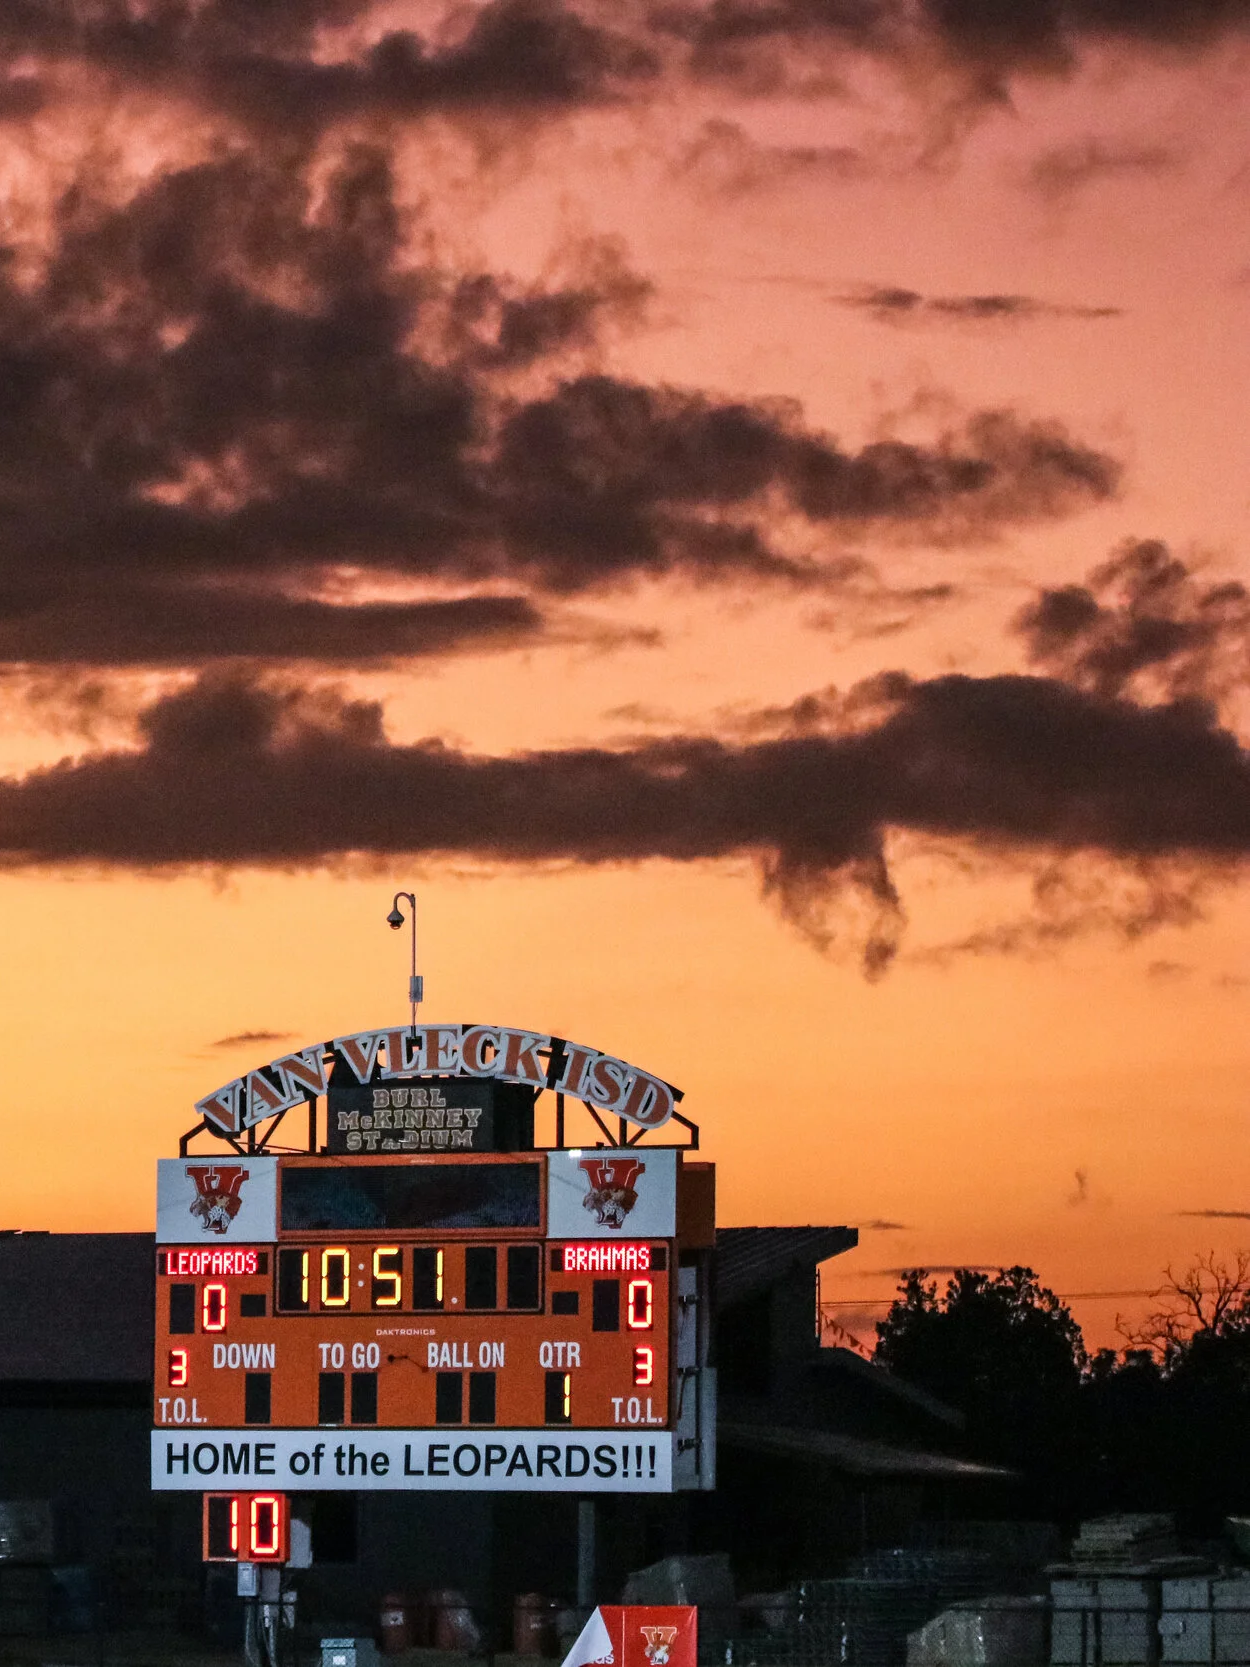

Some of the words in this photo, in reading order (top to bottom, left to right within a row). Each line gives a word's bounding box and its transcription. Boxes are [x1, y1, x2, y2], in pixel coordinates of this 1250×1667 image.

[194, 1043, 328, 1132] VAN
[333, 1024, 552, 1088] VLECK
[554, 1042, 673, 1129] ISD
[373, 1089, 446, 1108] BURL
[338, 1108, 482, 1130] McKINNEY
[166, 1250, 258, 1275] LEOPARDS
[564, 1246, 651, 1271] BRAHMAS
[202, 1284, 227, 1332] 0
[628, 1280, 653, 1329] 0
[376, 1328, 436, 1336] DAKTRONICS
[213, 1344, 275, 1368] DOWN
[319, 1343, 345, 1368] TO
[352, 1343, 380, 1368] GO
[427, 1342, 474, 1368] BALL
[480, 1342, 505, 1368] ON
[539, 1341, 581, 1368] QTR
[635, 1347, 653, 1386] 3
[170, 1350, 188, 1386] 3
[563, 1373, 571, 1418] 1
[159, 1398, 207, 1424] T.O.L.
[612, 1398, 663, 1424] T.O.L.
[166, 1443, 276, 1475] HOME
[289, 1443, 324, 1476] of
[334, 1443, 390, 1476] the
[403, 1444, 657, 1479] LEOPARDS!!!
[230, 1497, 280, 1554] 10
